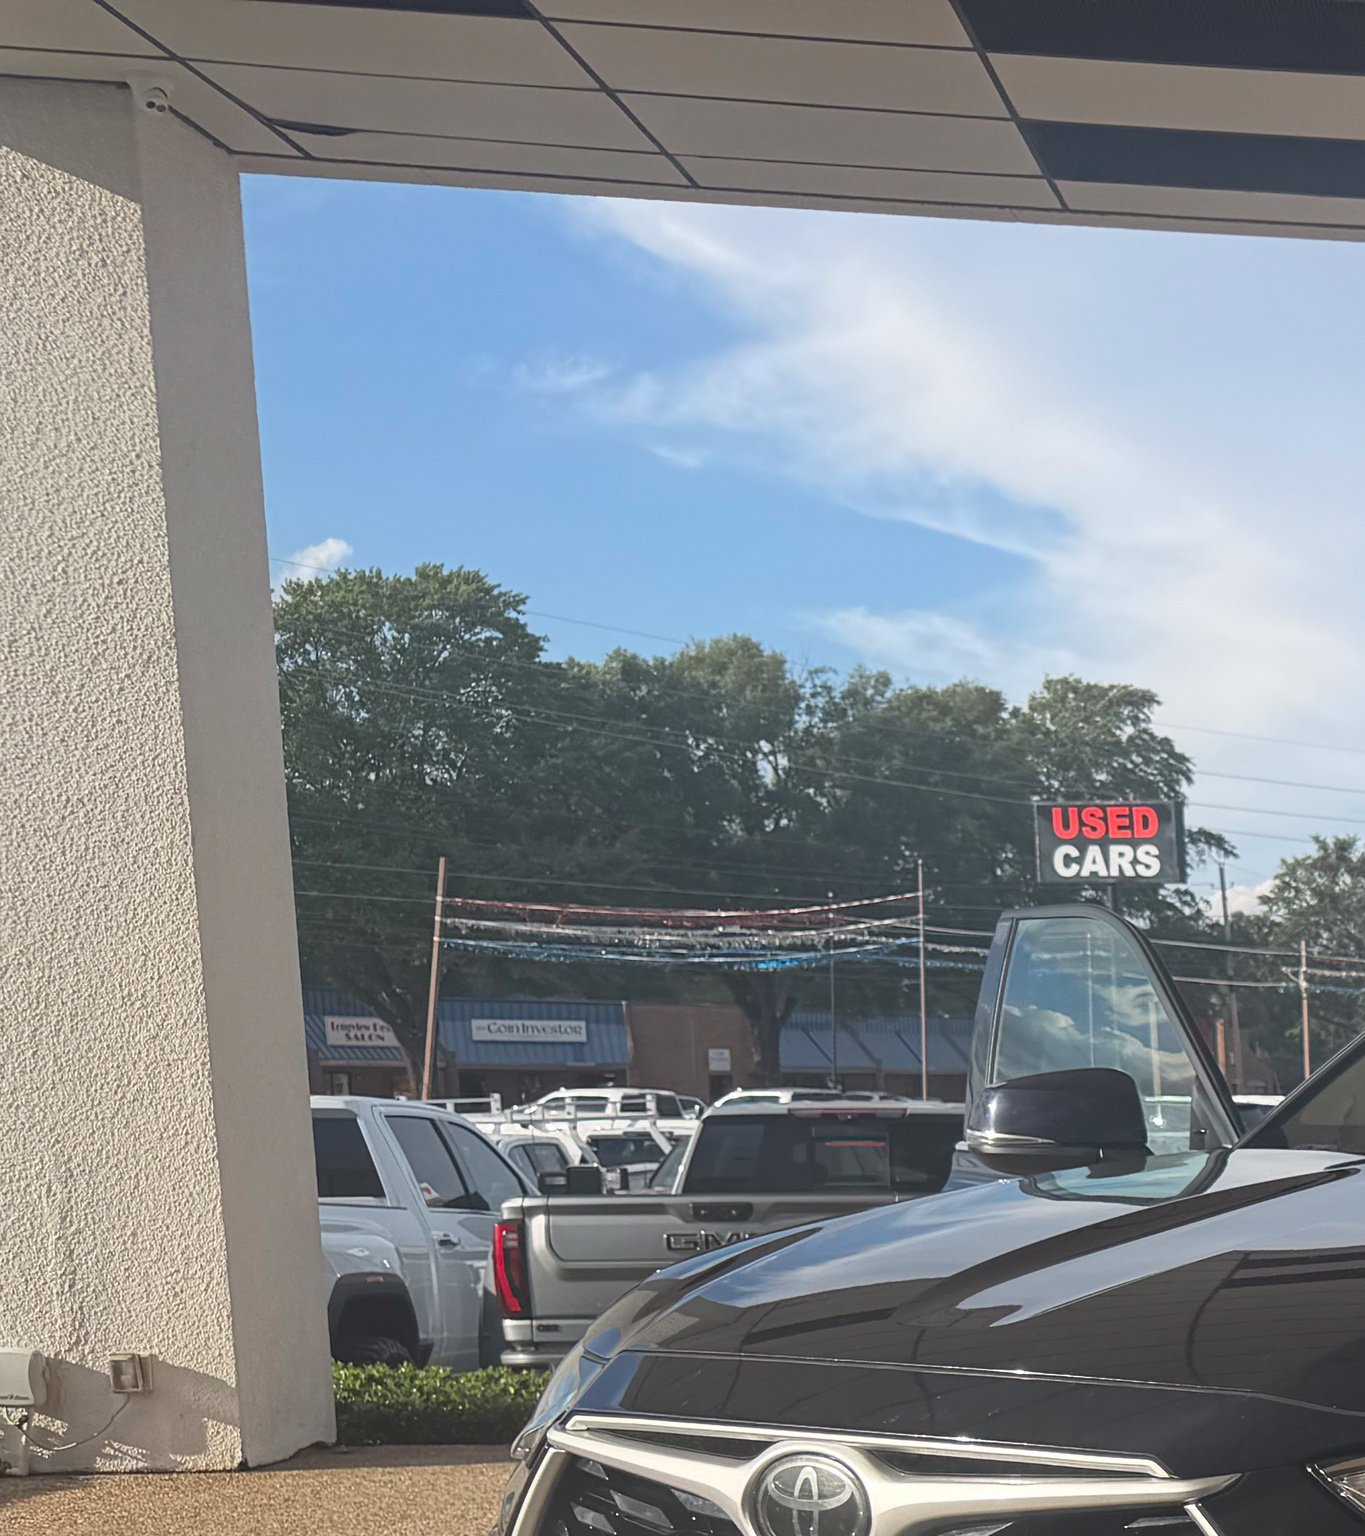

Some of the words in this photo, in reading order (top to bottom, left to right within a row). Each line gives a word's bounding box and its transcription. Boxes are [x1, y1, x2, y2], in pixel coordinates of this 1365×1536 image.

[1052, 806, 1159, 839] USED
[1053, 844, 1161, 877] CARS
[663, 1229, 757, 1251] GM
